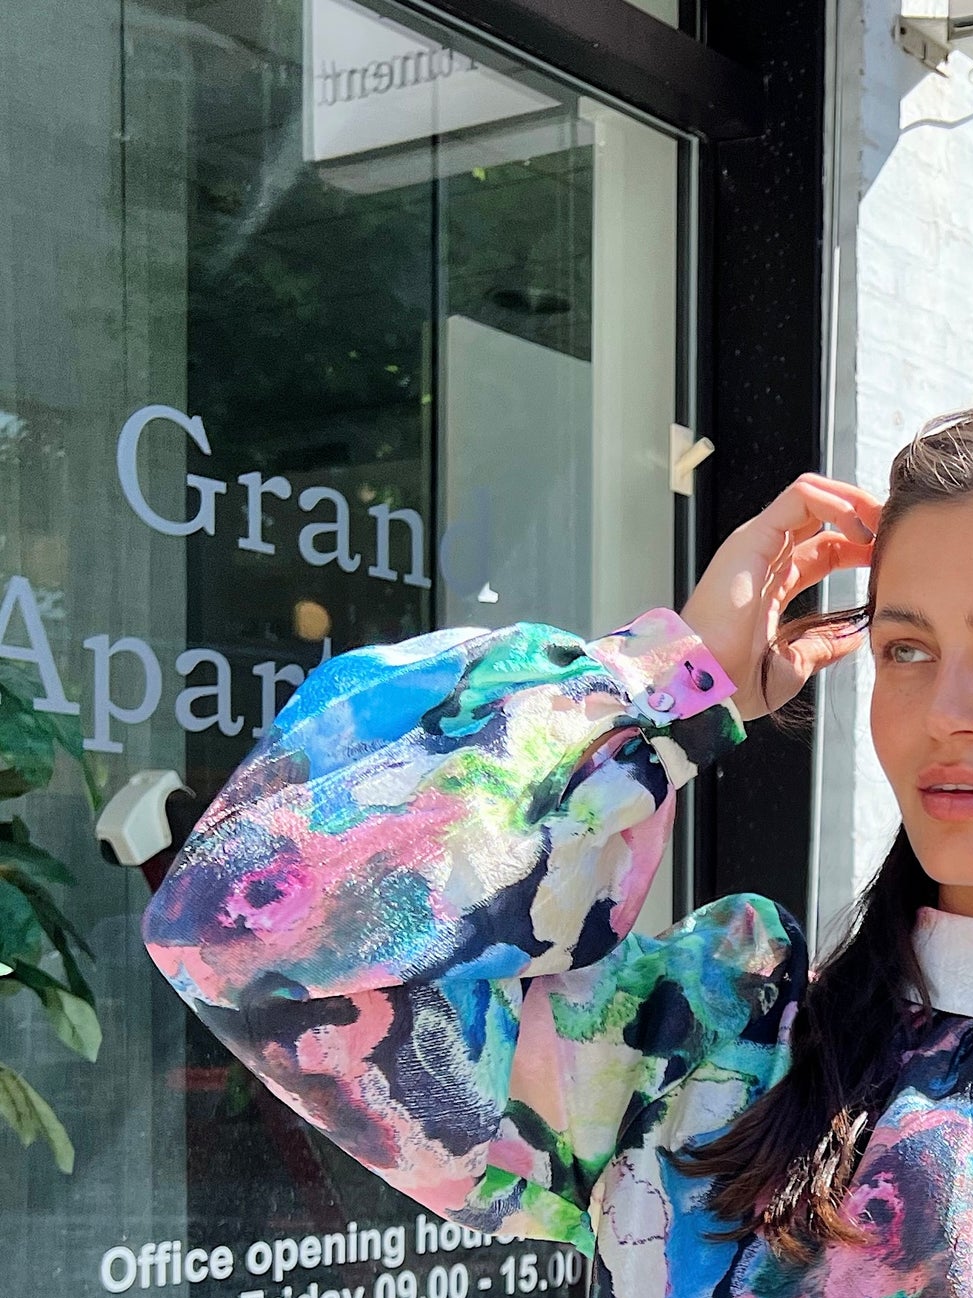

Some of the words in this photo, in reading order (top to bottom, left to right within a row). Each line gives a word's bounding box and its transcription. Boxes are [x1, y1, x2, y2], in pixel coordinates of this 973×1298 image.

[117, 404, 499, 603] Grand
[0, 575, 333, 753] Apar
[101, 1240, 233, 1293] Office
[246, 1221, 405, 1284] opening
[500, 1249, 583, 1296] 15.00
